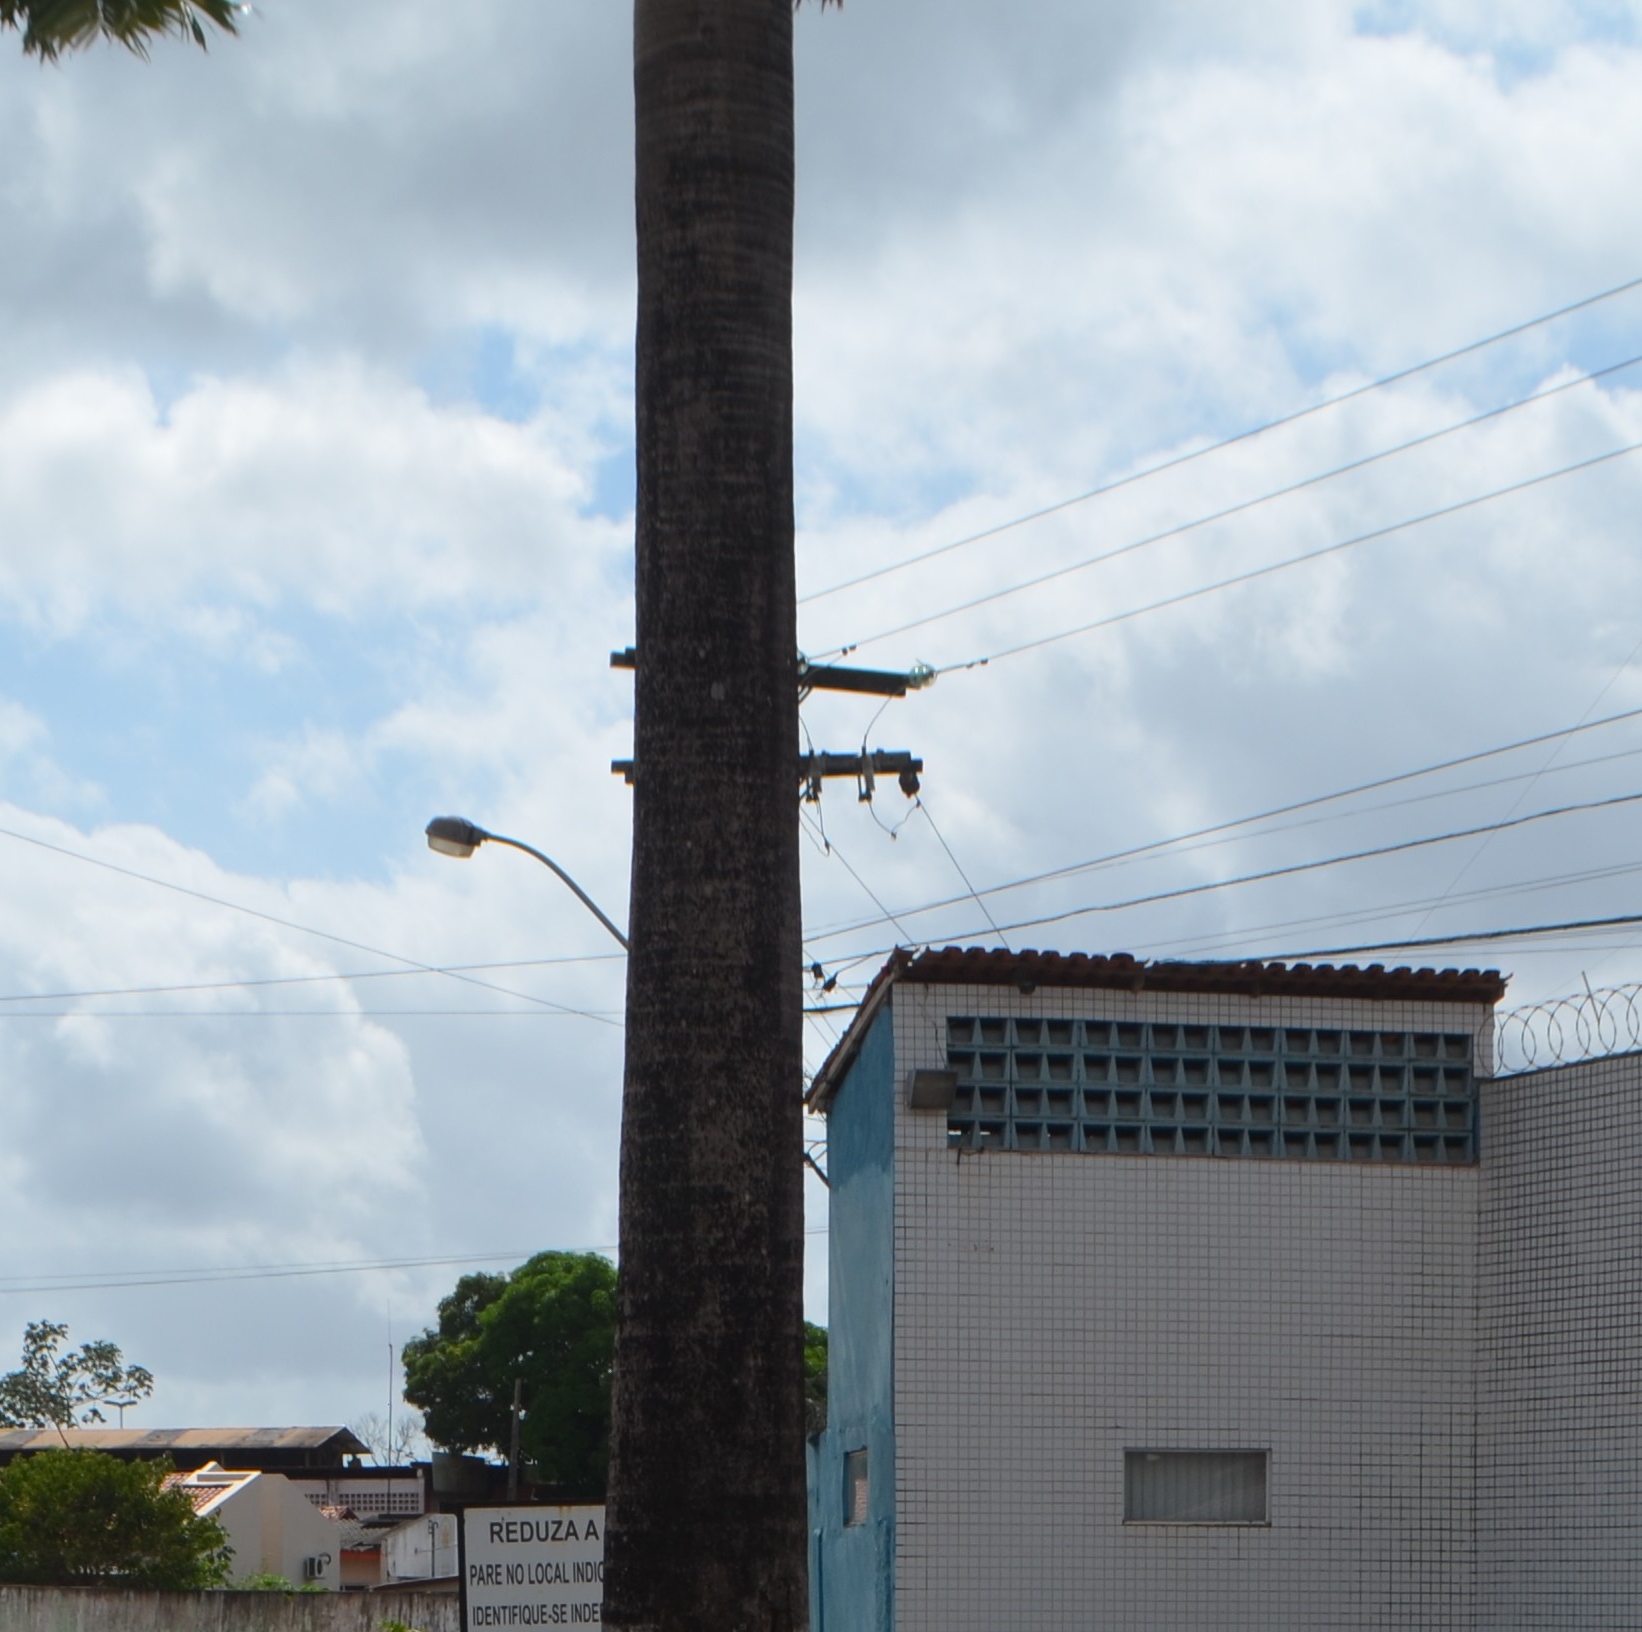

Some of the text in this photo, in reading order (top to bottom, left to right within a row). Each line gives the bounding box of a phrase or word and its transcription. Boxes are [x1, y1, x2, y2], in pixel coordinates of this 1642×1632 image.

[489, 1520, 600, 1543] REDUZA A
[470, 1561, 605, 1586] PARE NO LOCAL INDIC
[472, 1603, 603, 1626] IDENTIFIQUE-SE INDE
